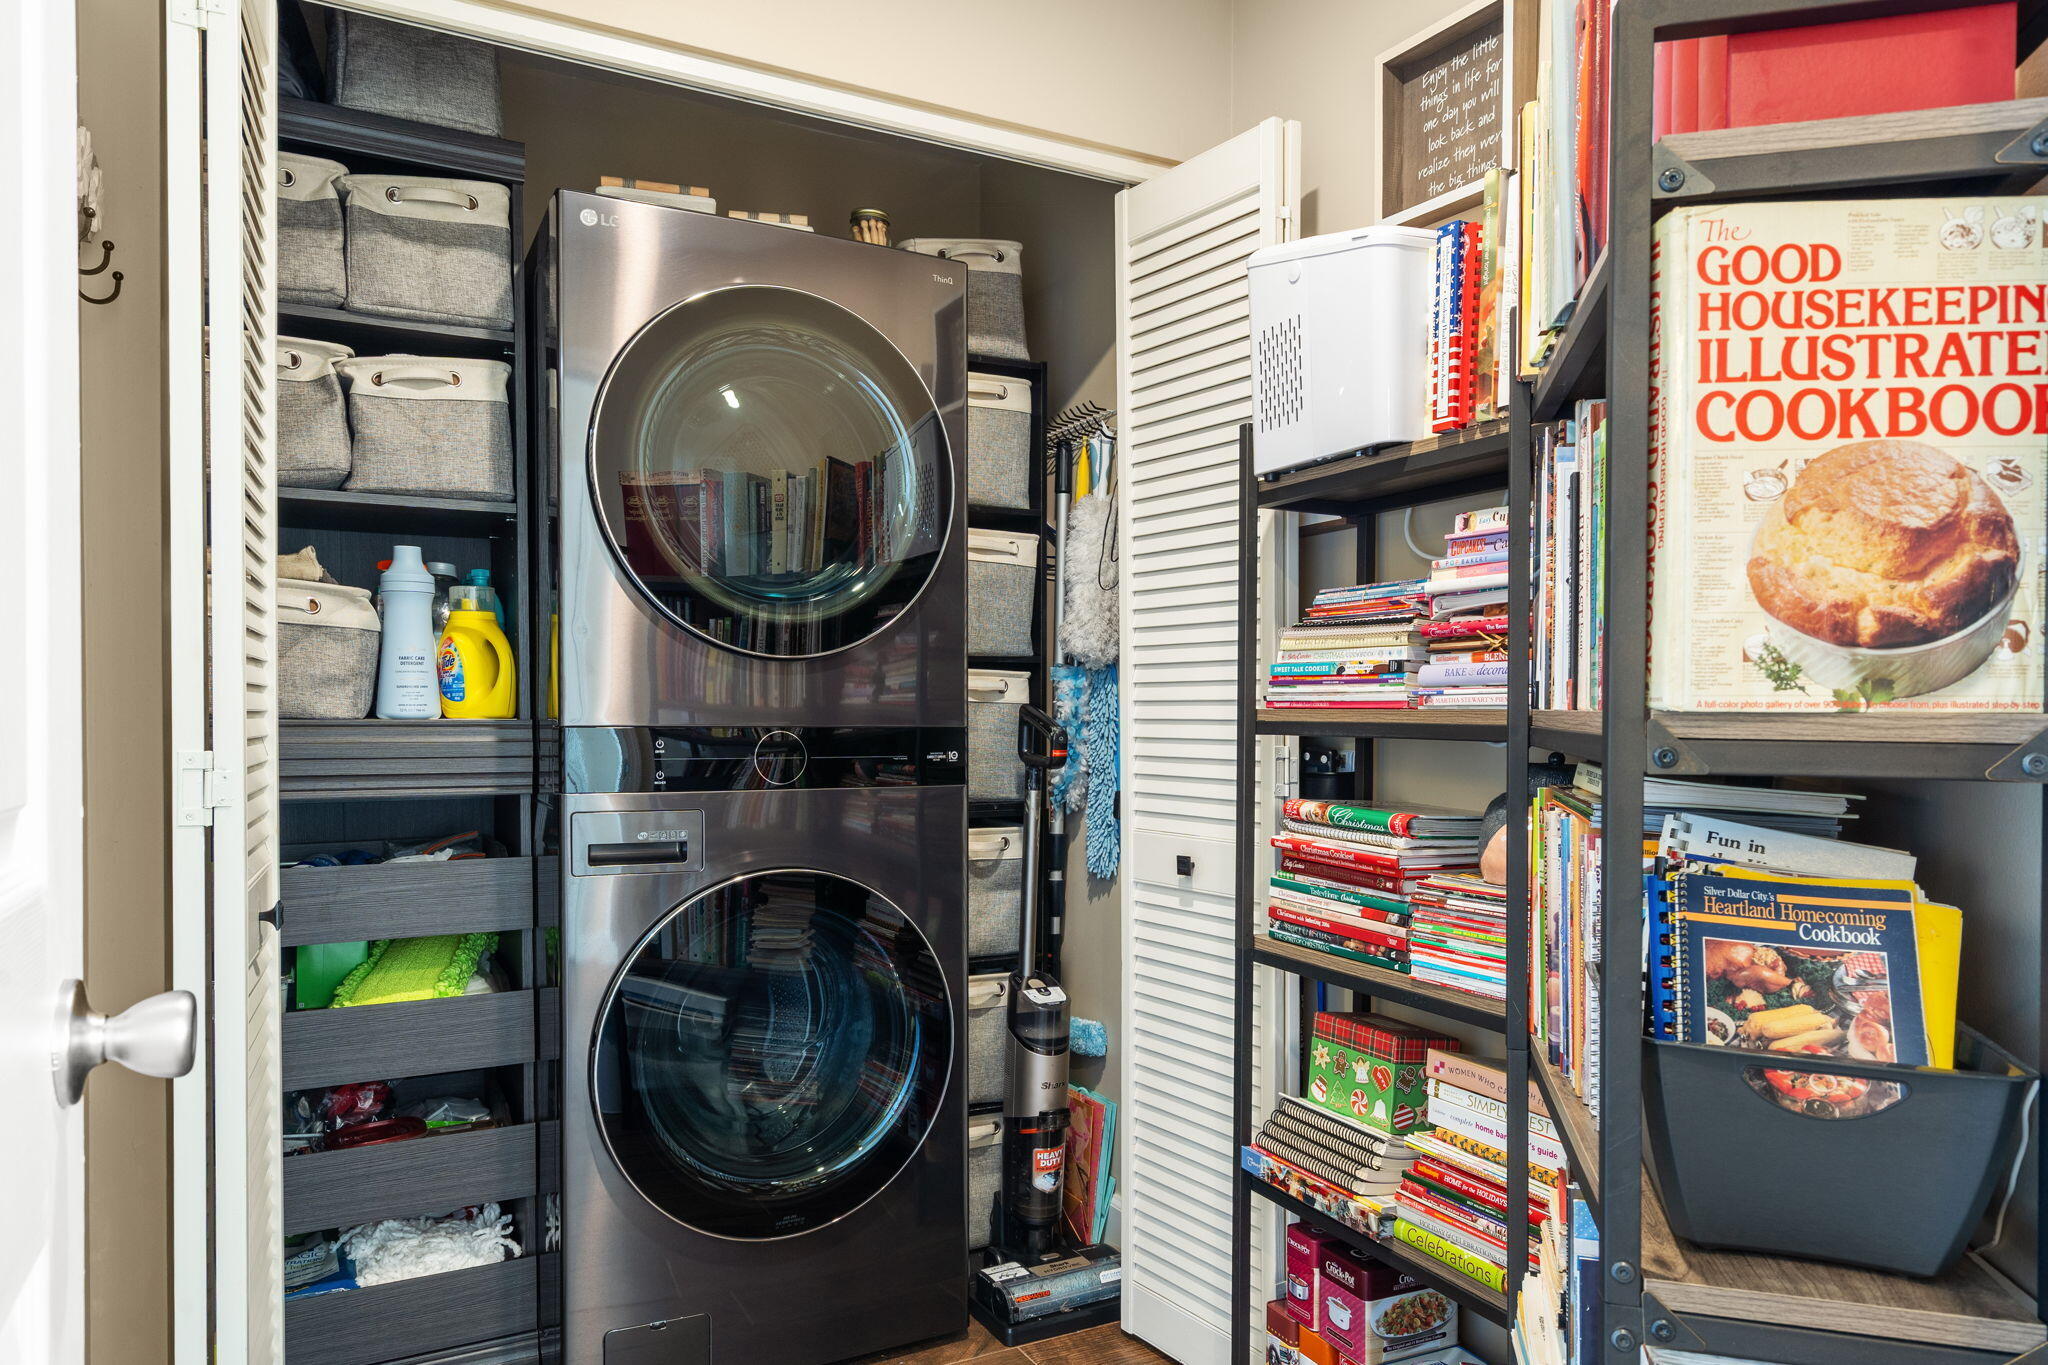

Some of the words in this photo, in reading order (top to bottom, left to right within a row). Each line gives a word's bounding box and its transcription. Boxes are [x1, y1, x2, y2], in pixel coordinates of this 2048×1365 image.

[1422, 65, 1448, 95] Enjoy
[1451, 52, 1469, 72] the
[1472, 34, 1499, 61] little
[1419, 86, 1449, 113] things
[1452, 80, 1461, 94] in
[1464, 67, 1482, 91] life
[1485, 57, 1502, 79] for
[1423, 116, 1439, 133] one
[1442, 103, 1459, 124] day
[1462, 97, 1477, 119] you
[1480, 79, 1500, 102] will
[1428, 132, 1448, 153] look
[1450, 119, 1475, 140] back
[1478, 105, 1496, 128] and
[1418, 156, 1450, 180] realize
[1453, 144, 1476, 166] they
[1427, 179, 1446, 197] the
[1449, 167, 1466, 190] big
[1699, 218, 1752, 242] The
[1697, 243, 1842, 286] GOOD
[932, 274, 953, 285] ThinQ
[1697, 284, 2048, 331] HOUSEKEEPIN
[1697, 330, 2048, 384] ILLUSTRATE
[1660, 396, 1668, 440] GOOD
[1657, 441, 1668, 550] HOUSEKEEPING
[442, 655, 455, 669] Tide
[1274, 665, 1291, 673] SWEET
[1291, 665, 1304, 673] TALK
[1304, 664, 1329, 672] COOKIES
[1444, 667, 1467, 677] BAKE
[1740, 699, 1763, 711] photo
[1765, 699, 1792, 711] gallery
[1804, 701, 1821, 709] over
[1932, 700, 1949, 711] plus
[1950, 700, 1989, 710] illustrated
[1331, 807, 1385, 832] Christmas
[1300, 844, 1330, 856] Christmas
[1705, 830, 1741, 850] Fun
[1747, 839, 1766, 855] in
[1703, 885, 1725, 898] Silver
[1727, 887, 1750, 900] Dollar
[1703, 895, 1776, 920] Heartland
[1780, 903, 1887, 930] Homecoming
[1301, 939, 1330, 952] CHRISTMAS
[1799, 923, 1883, 946] Cookbook
[1041, 1080, 1066, 1090] Shark
[1447, 1066, 1476, 1079] WOMEN
[1477, 1073, 1496, 1089] WHO
[1466, 1094, 1507, 1119] SIMPLY
[1449, 1114, 1474, 1128] complete
[1475, 1121, 1494, 1136] home
[1537, 1146, 1558, 1160] guide
[1037, 1149, 1063, 1160] HEAVY
[1040, 1157, 1061, 1167] DUTY
[1443, 1173, 1462, 1188] HOME
[1468, 1185, 1476, 1195] the
[1476, 1188, 1508, 1207] HOLIDAYS
[1407, 1227, 1491, 1283] Celebrations
